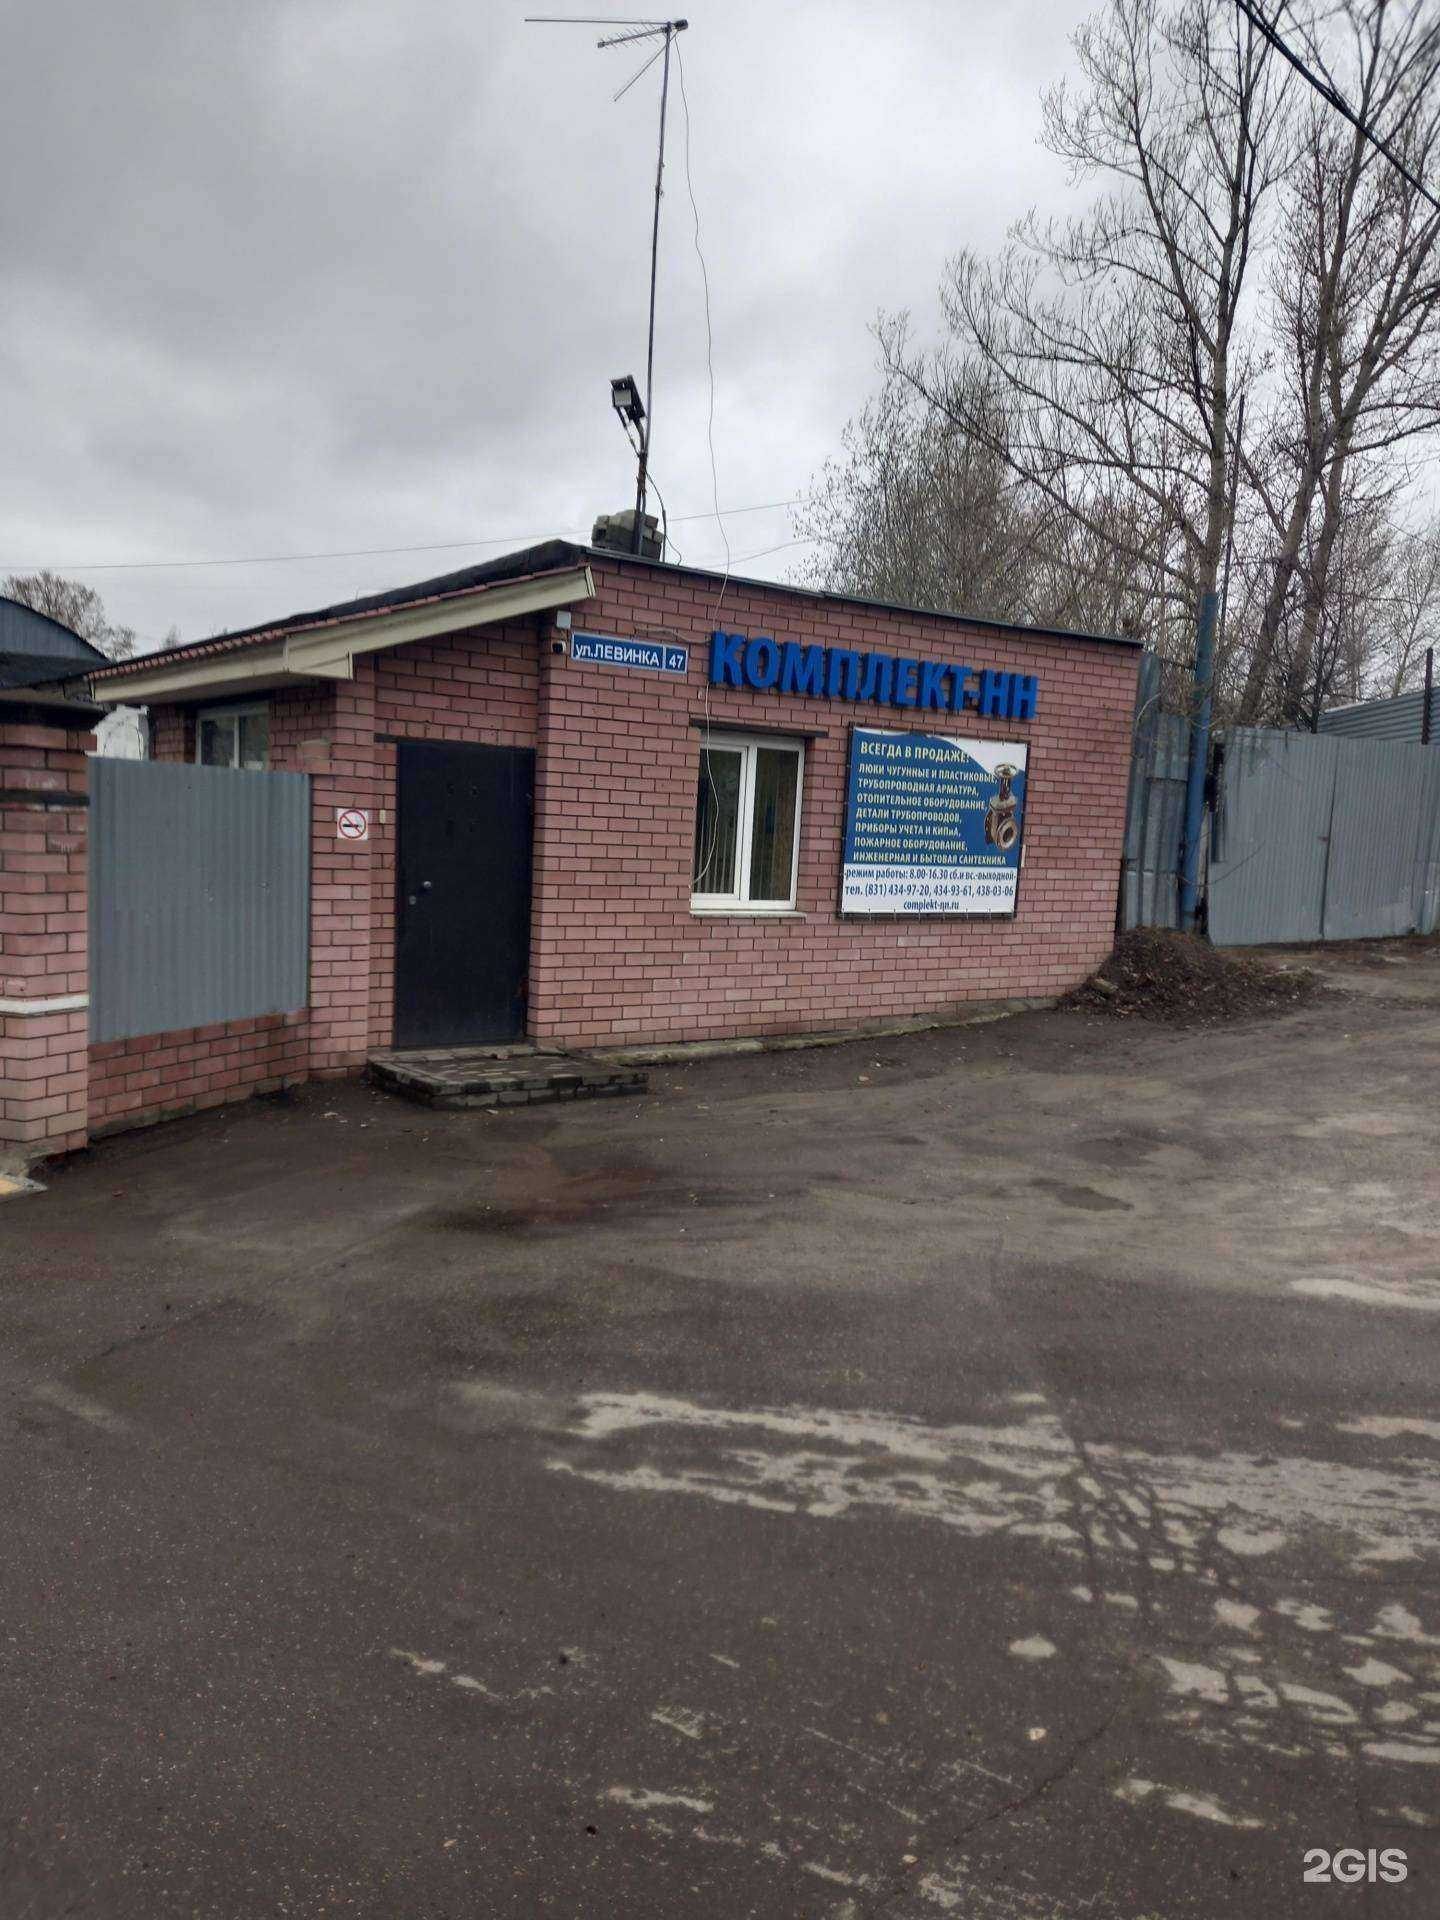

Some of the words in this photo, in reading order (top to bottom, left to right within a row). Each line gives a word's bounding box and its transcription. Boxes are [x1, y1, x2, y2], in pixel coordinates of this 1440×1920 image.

[669, 655, 683, 669] 47
[708, 631, 1039, 720] КОМПЛЕКТ-НН
[860, 741, 902, 757] ВСЕГДА
[905, 747, 912, 758] В
[914, 747, 970, 763] ПРОДАЖЕ:
[859, 763, 884, 774] ЛЮКИ
[887, 766, 929, 778] ЧУГУННЫЕ
[932, 770, 937, 779] И
[939, 770, 998, 784] ПЛАСТИКОВЫЕ,
[858, 778, 935, 793] ТРУБОПРОВОДНАЯ
[936, 786, 979, 797] АРМАТУРА,
[857, 793, 922, 806] ОТОПИТЕЛЬНОЕ
[924, 800, 988, 811] ОБОРУДОВАНИЕ,
[856, 808, 889, 818] ДЕТАЛИ
[891, 811, 962, 824] ТРУБОПРОВОДОВ,
[855, 822, 898, 833] ПРИБОРЫ
[900, 826, 923, 835] УЧЕТА
[855, 837, 901, 848] ПОЖАРНОЕ
[903, 840, 968, 851] ОБОРУДОВАНИЕ,
[853, 852, 910, 863] ИНЖЕНЕРНАЯ
[912, 854, 918, 862] И
[920, 854, 957, 864] БЫТОВАЯ
[959, 855, 1006, 865] САНТЕХНИКА
[876, 868, 908, 880] работы:
[845, 886, 863, 894] тел.
[865, 883, 887, 897] (831)
[888, 884, 932, 897] 434-97-20,
[934, 885, 975, 897] 434-93-61,
[976, 886, 1014, 896] 438-03-06
